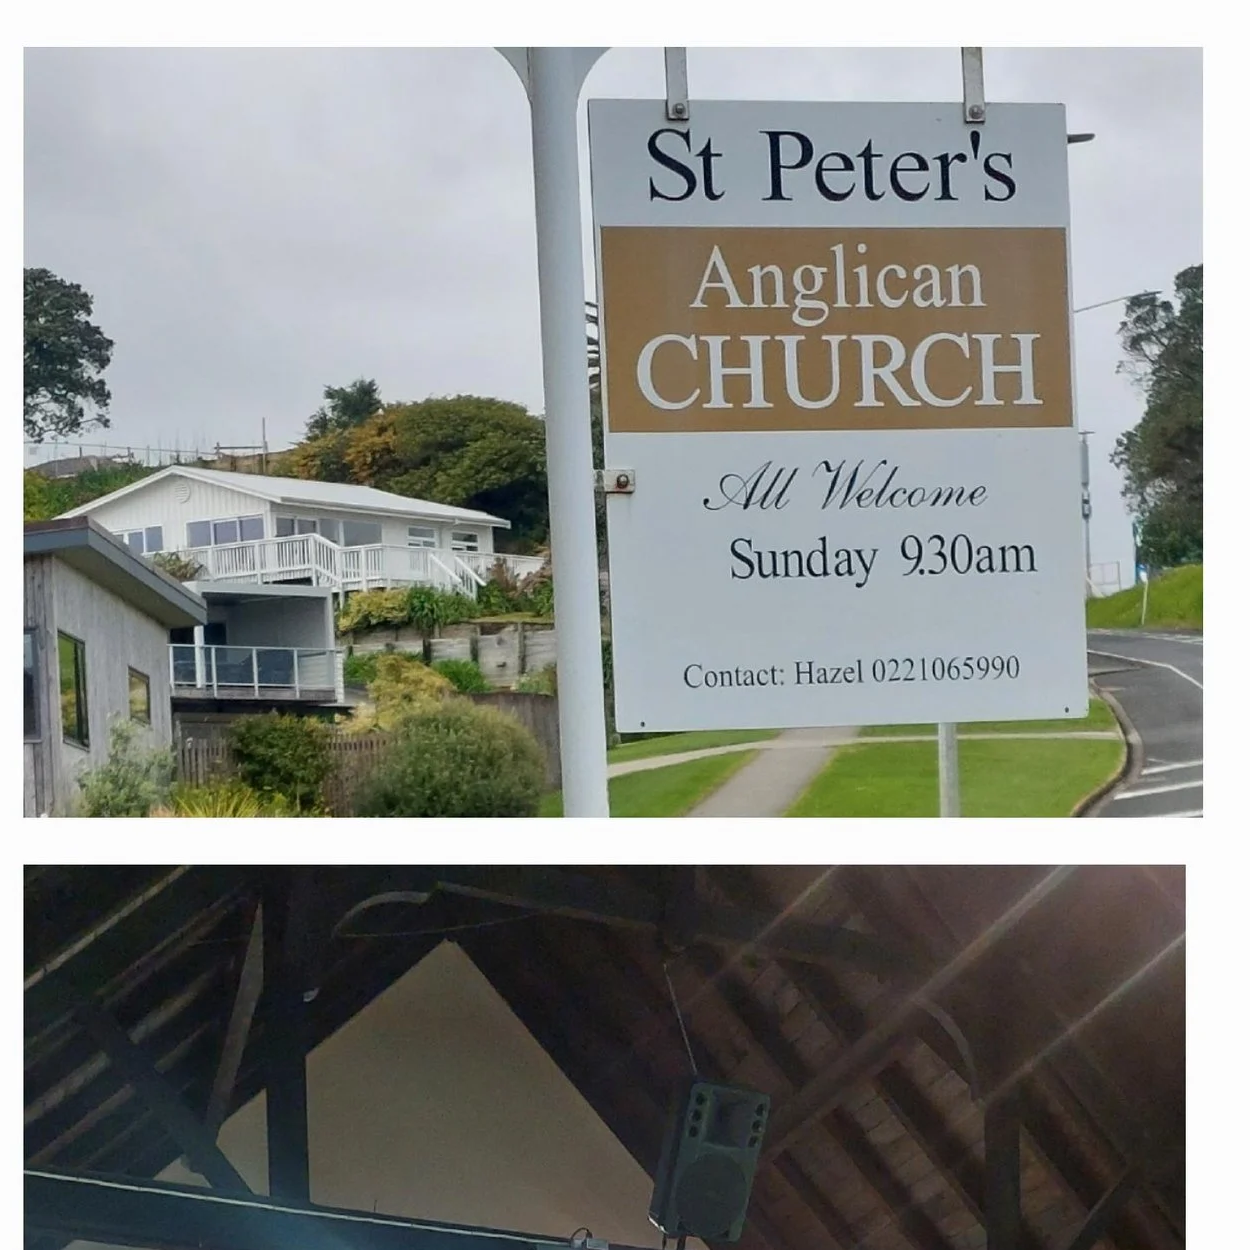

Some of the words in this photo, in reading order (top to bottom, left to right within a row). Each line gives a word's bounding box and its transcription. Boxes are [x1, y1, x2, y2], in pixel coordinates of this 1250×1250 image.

[647, 127, 726, 203] St
[759, 129, 1017, 203] Peter's
[689, 242, 987, 327] Anglican
[636, 332, 1044, 411] CHURCH
[703, 460, 799, 512] All
[812, 459, 988, 511] Welcome
[730, 535, 879, 589] Sunday
[900, 533, 1038, 577] 9.30am
[683, 663, 785, 689] Contact:
[794, 659, 864, 685] Hazel
[872, 655, 1020, 684] 0221065990
